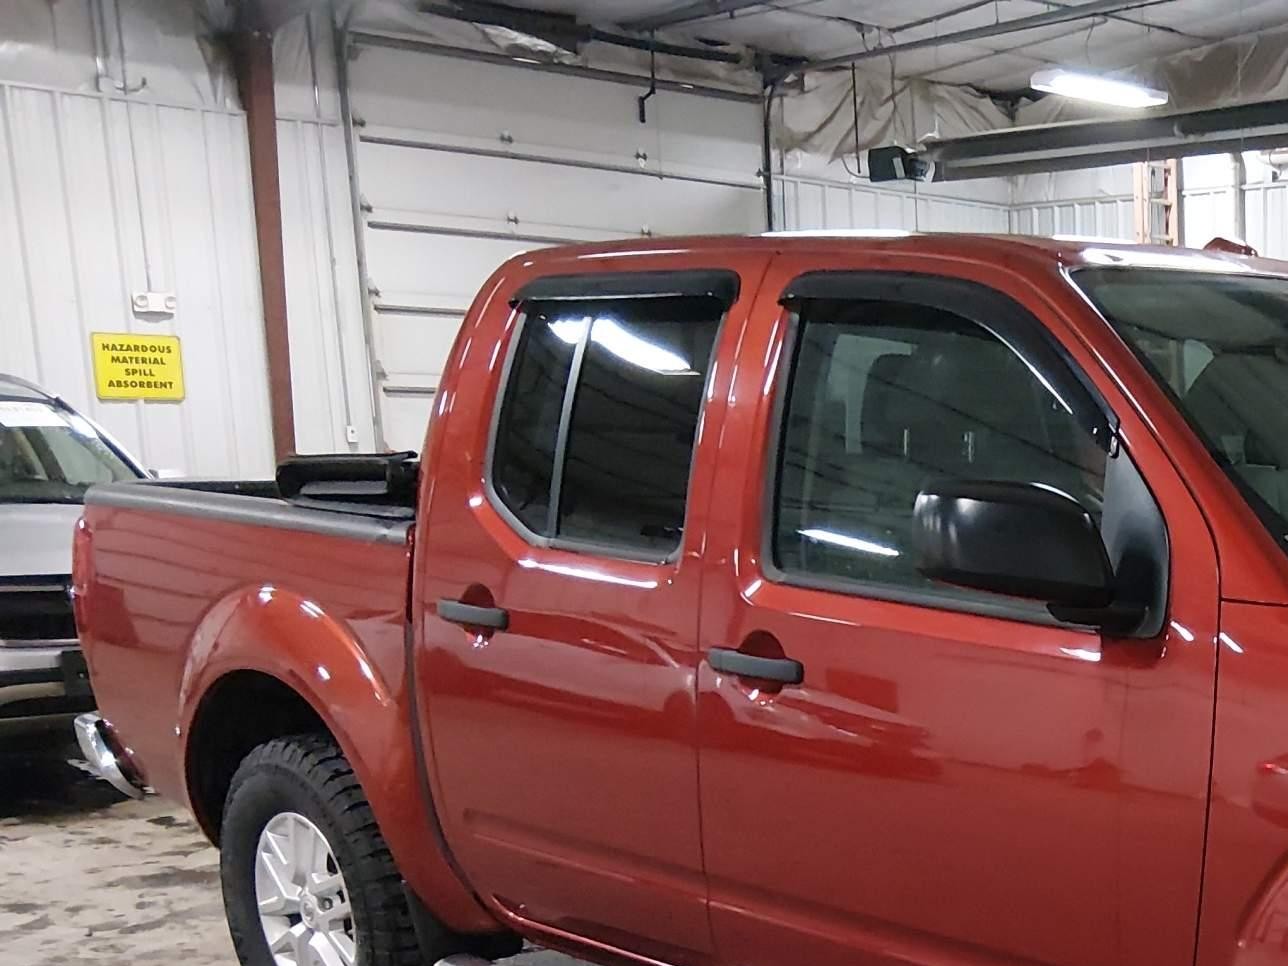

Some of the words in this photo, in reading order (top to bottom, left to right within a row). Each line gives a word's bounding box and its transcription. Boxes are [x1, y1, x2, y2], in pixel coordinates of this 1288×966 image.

[101, 343, 172, 354] HAZARDOUS
[111, 355, 166, 365] MATERIAL
[124, 368, 156, 377] SPILL
[107, 380, 174, 389] ABSORBENT
